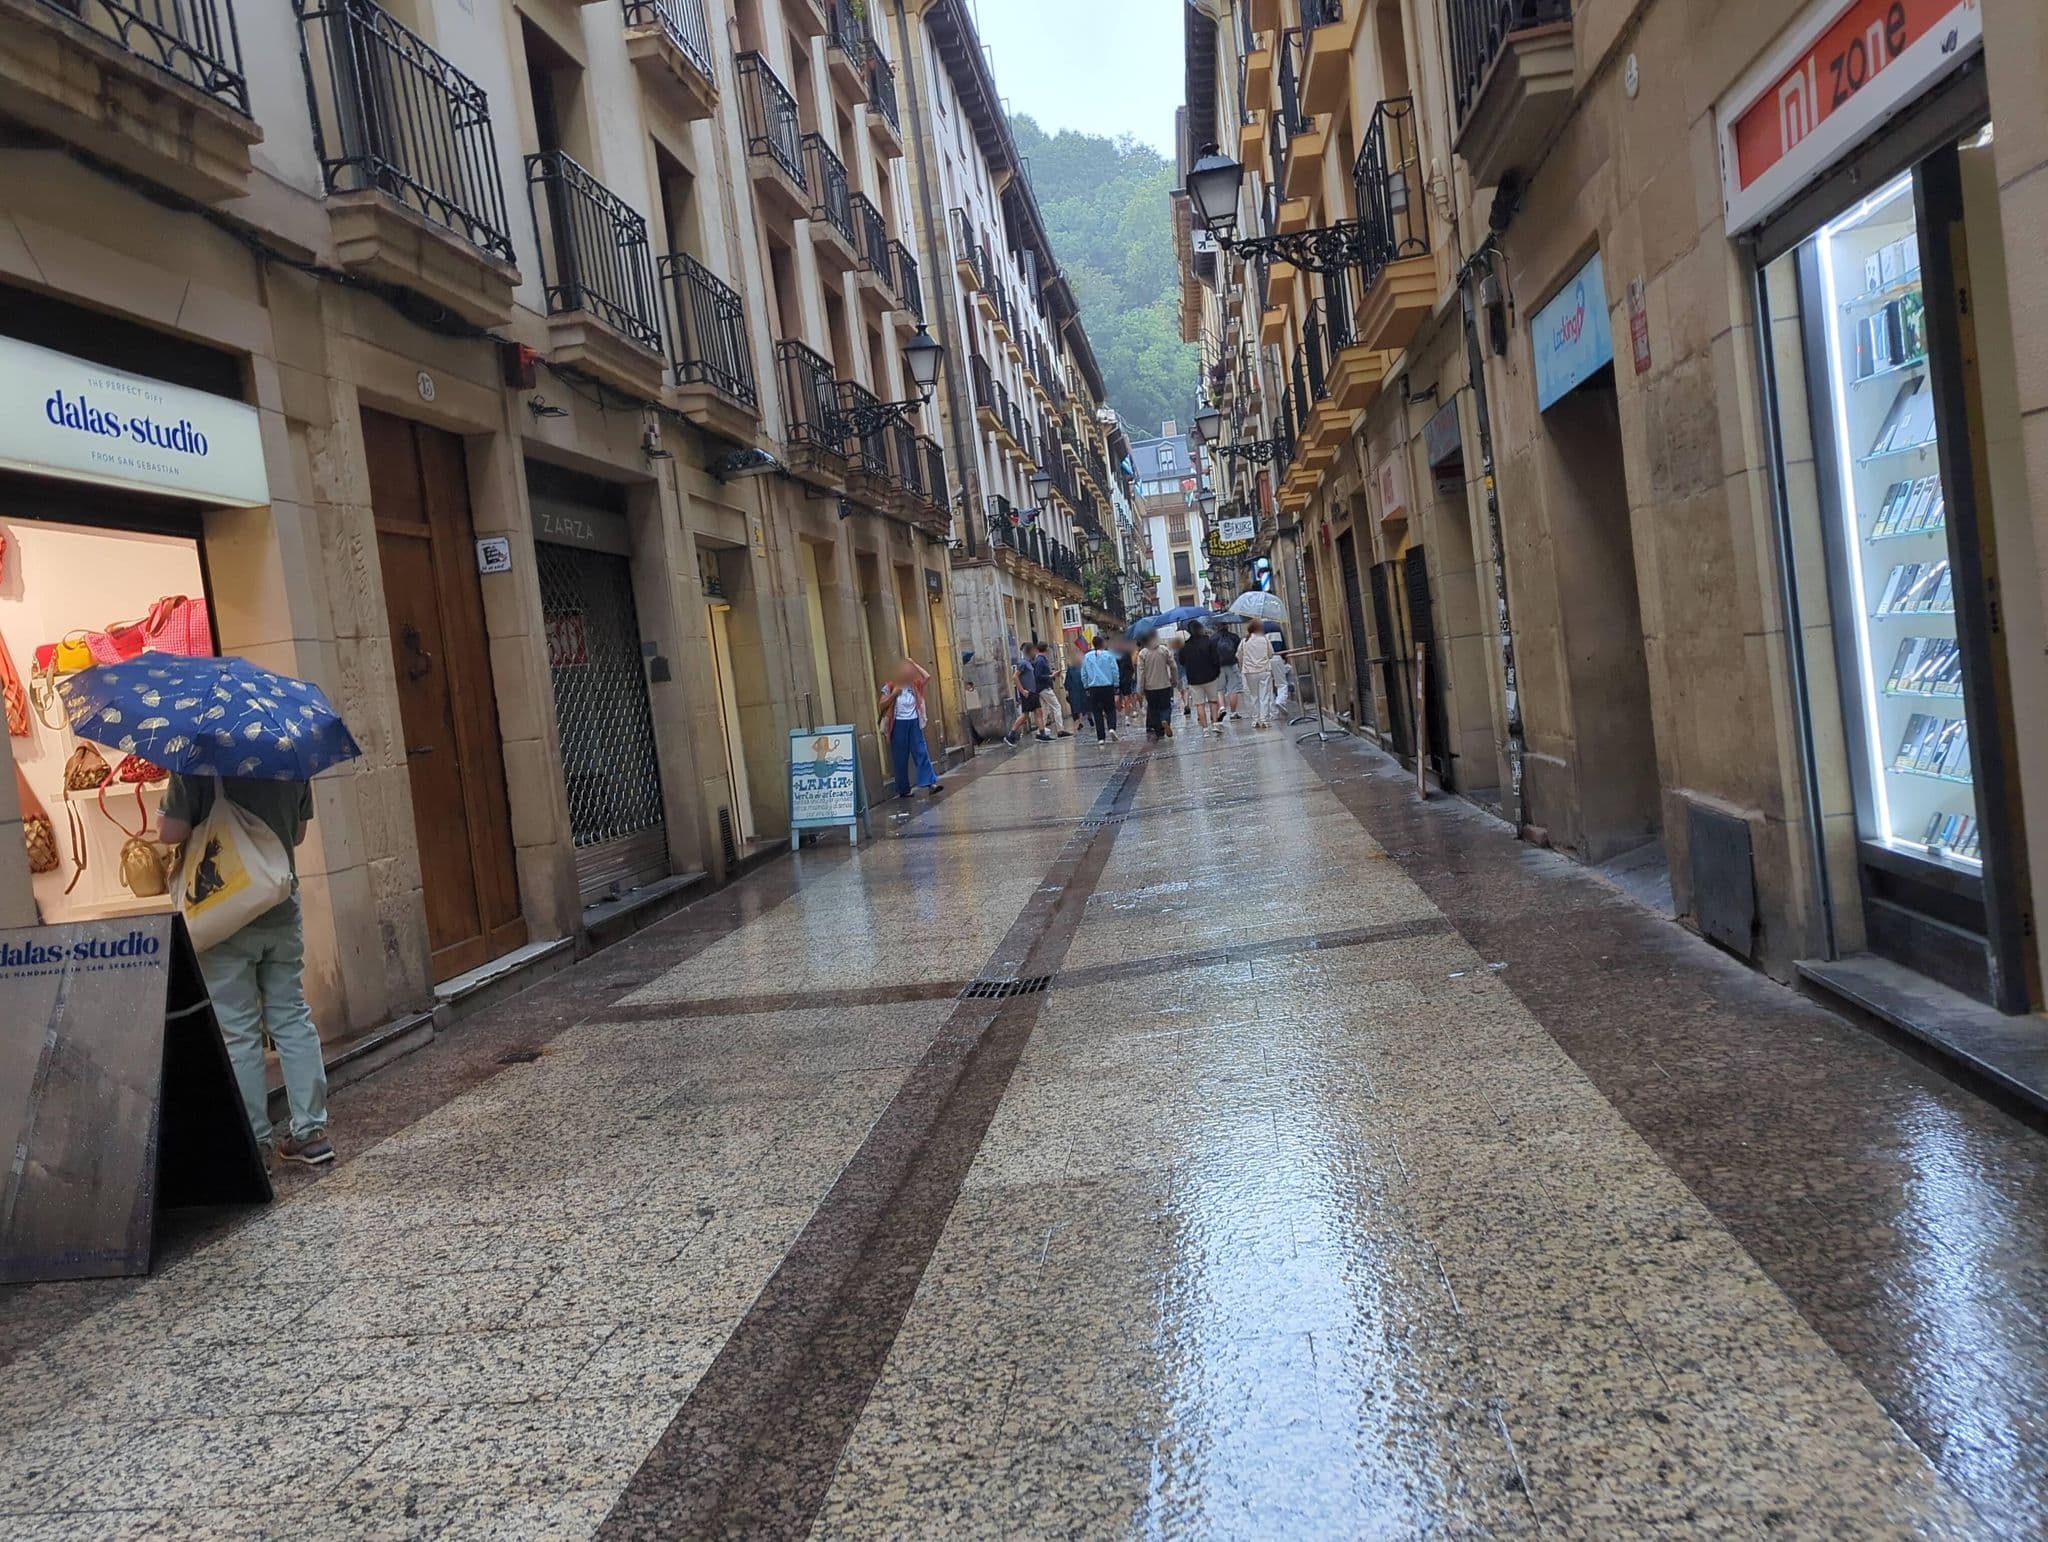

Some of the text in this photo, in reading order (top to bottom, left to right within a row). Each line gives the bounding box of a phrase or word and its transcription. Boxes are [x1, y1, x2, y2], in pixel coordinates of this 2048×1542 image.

[1830, 2, 1906, 113] zone
[88, 378, 164, 405] THE PERFECT GIFT
[92, 451, 180, 475] FROM SAN SEBASTIAN
[541, 513, 594, 541] ZARZA
[14, 967, 66, 978] HANDMADE
[109, 960, 160, 970] SEBASTIAN
